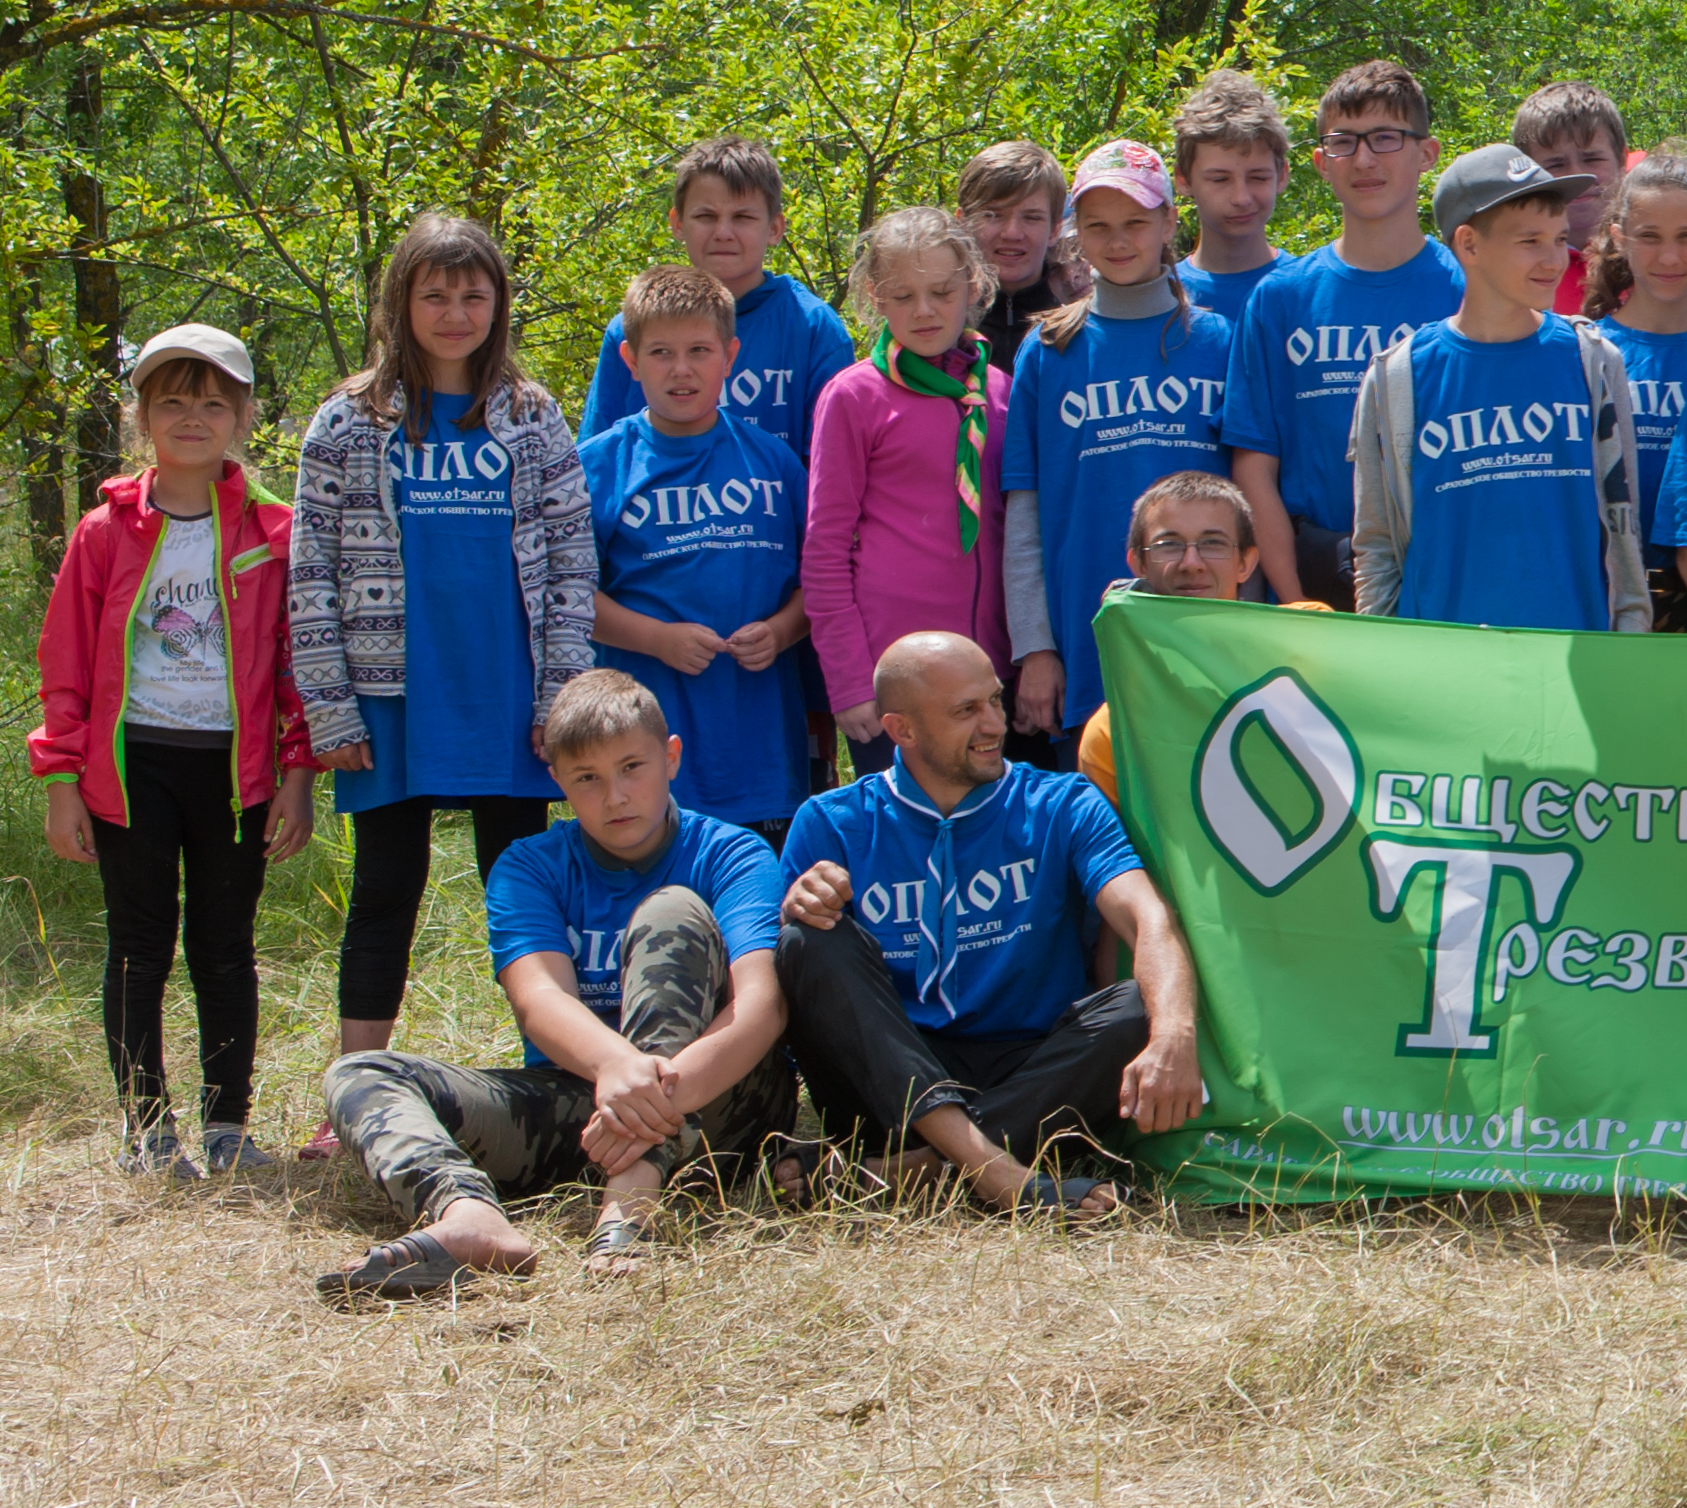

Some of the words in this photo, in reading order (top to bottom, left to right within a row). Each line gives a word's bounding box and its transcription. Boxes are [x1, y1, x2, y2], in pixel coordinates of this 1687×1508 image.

[1060, 375, 1225, 429] ОПЛОТ
[1096, 419, 1186, 440] www.otsar.ru
[1418, 402, 1589, 459] ОПЛОТ
[1461, 452, 1553, 472] www.otsar.ru
[409, 487, 505, 501] www.otsar.ru
[666, 523, 753, 542] www.otsar.ru
